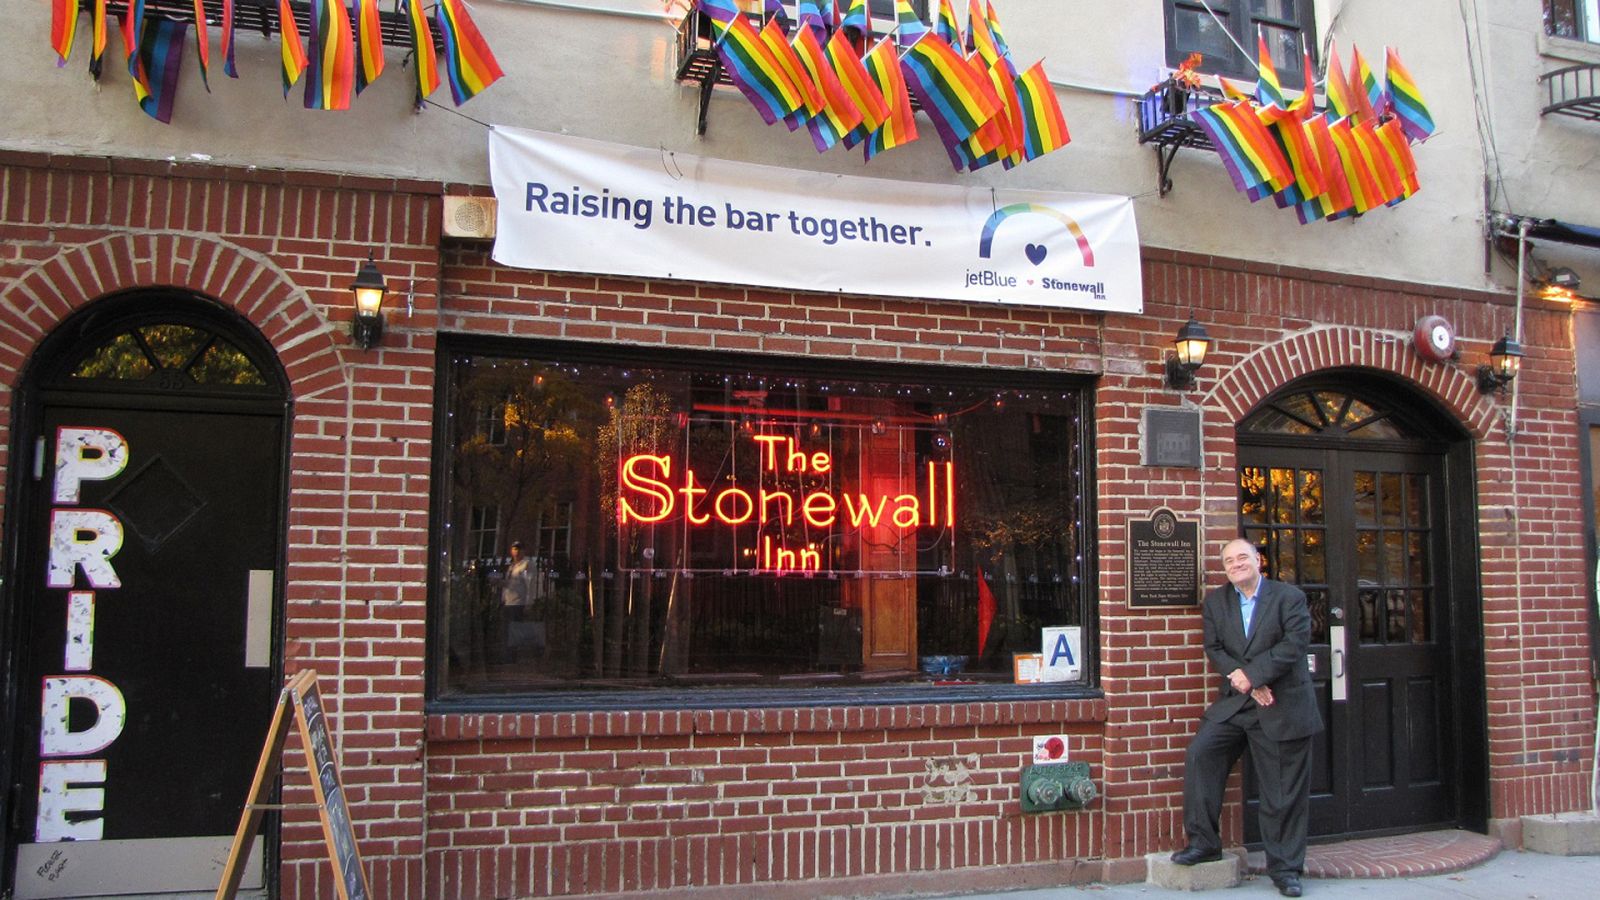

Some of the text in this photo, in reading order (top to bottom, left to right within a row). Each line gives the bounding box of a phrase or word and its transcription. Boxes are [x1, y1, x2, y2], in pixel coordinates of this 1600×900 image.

[525, 182, 932, 248] Raising the bar together.
[965, 269, 1104, 294] jetBlue Stonewall
[753, 434, 832, 473] The
[619, 454, 954, 529] Stonewall
[763, 535, 822, 572] Inn
[35, 425, 130, 843] PRIDE
[1050, 633, 1075, 667] A
